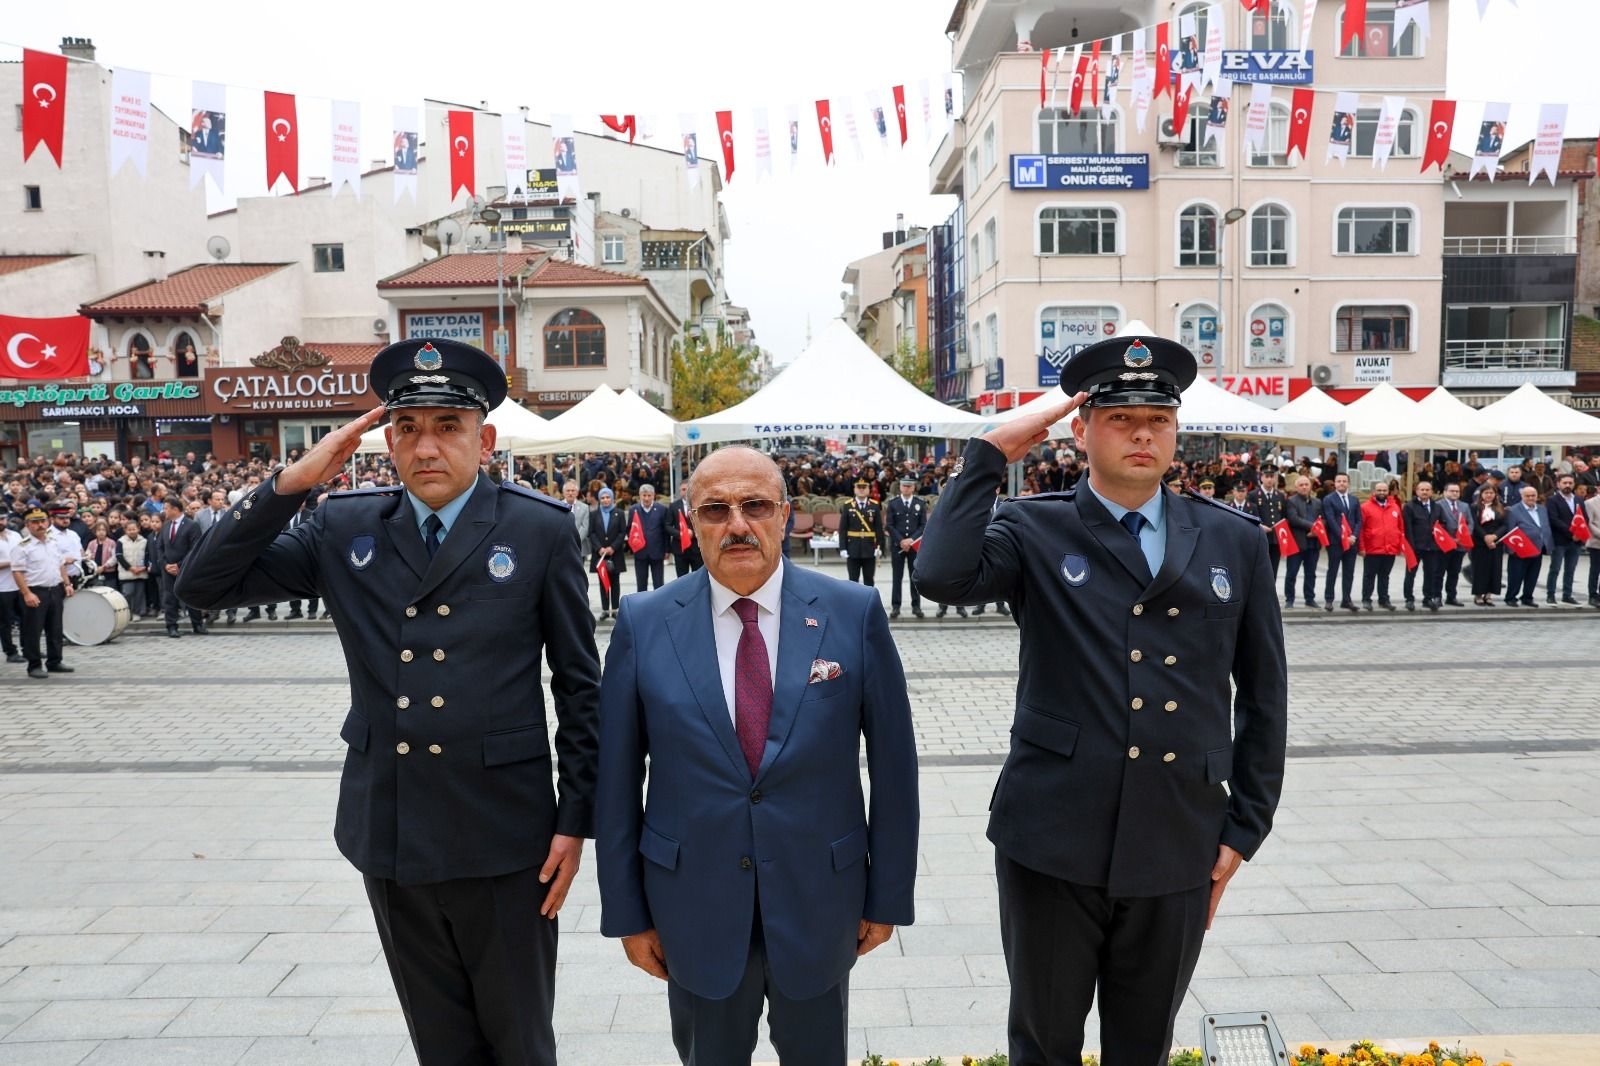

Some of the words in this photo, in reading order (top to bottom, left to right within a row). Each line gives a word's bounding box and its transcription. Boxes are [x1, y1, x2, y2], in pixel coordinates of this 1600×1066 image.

[1223, 51, 1313, 70] EVA
[1240, 72, 1257, 81] İLÇE
[1047, 156, 1088, 165] SERBEST
[1088, 155, 1147, 164] MUHASEBECİ
[1070, 165, 1090, 173] MALİ
[1090, 165, 1123, 174] MÜŞAVİR
[1060, 175, 1097, 185] ONUR
[1098, 175, 1133, 187] GENÇ
[410, 315, 480, 326] MEYDAN
[410, 327, 481, 338] KIRTASİYE
[1356, 357, 1391, 367] AVUKAT
[213, 368, 369, 403] ÇATALOĞLU
[1208, 376, 1284, 396] ZANE
[0, 383, 110, 407] aşköprü
[113, 382, 200, 402] Garlic
[252, 400, 333, 410] KUYUMCULUK
[42, 405, 105, 417] SARIMSAKÇI
[108, 405, 140, 415] HOCA
[754, 424, 835, 433] TAŞKÖPRÜ
[840, 423, 933, 433] BELEDİYESİ
[1186, 424, 1274, 434] BELEDİYESİ
